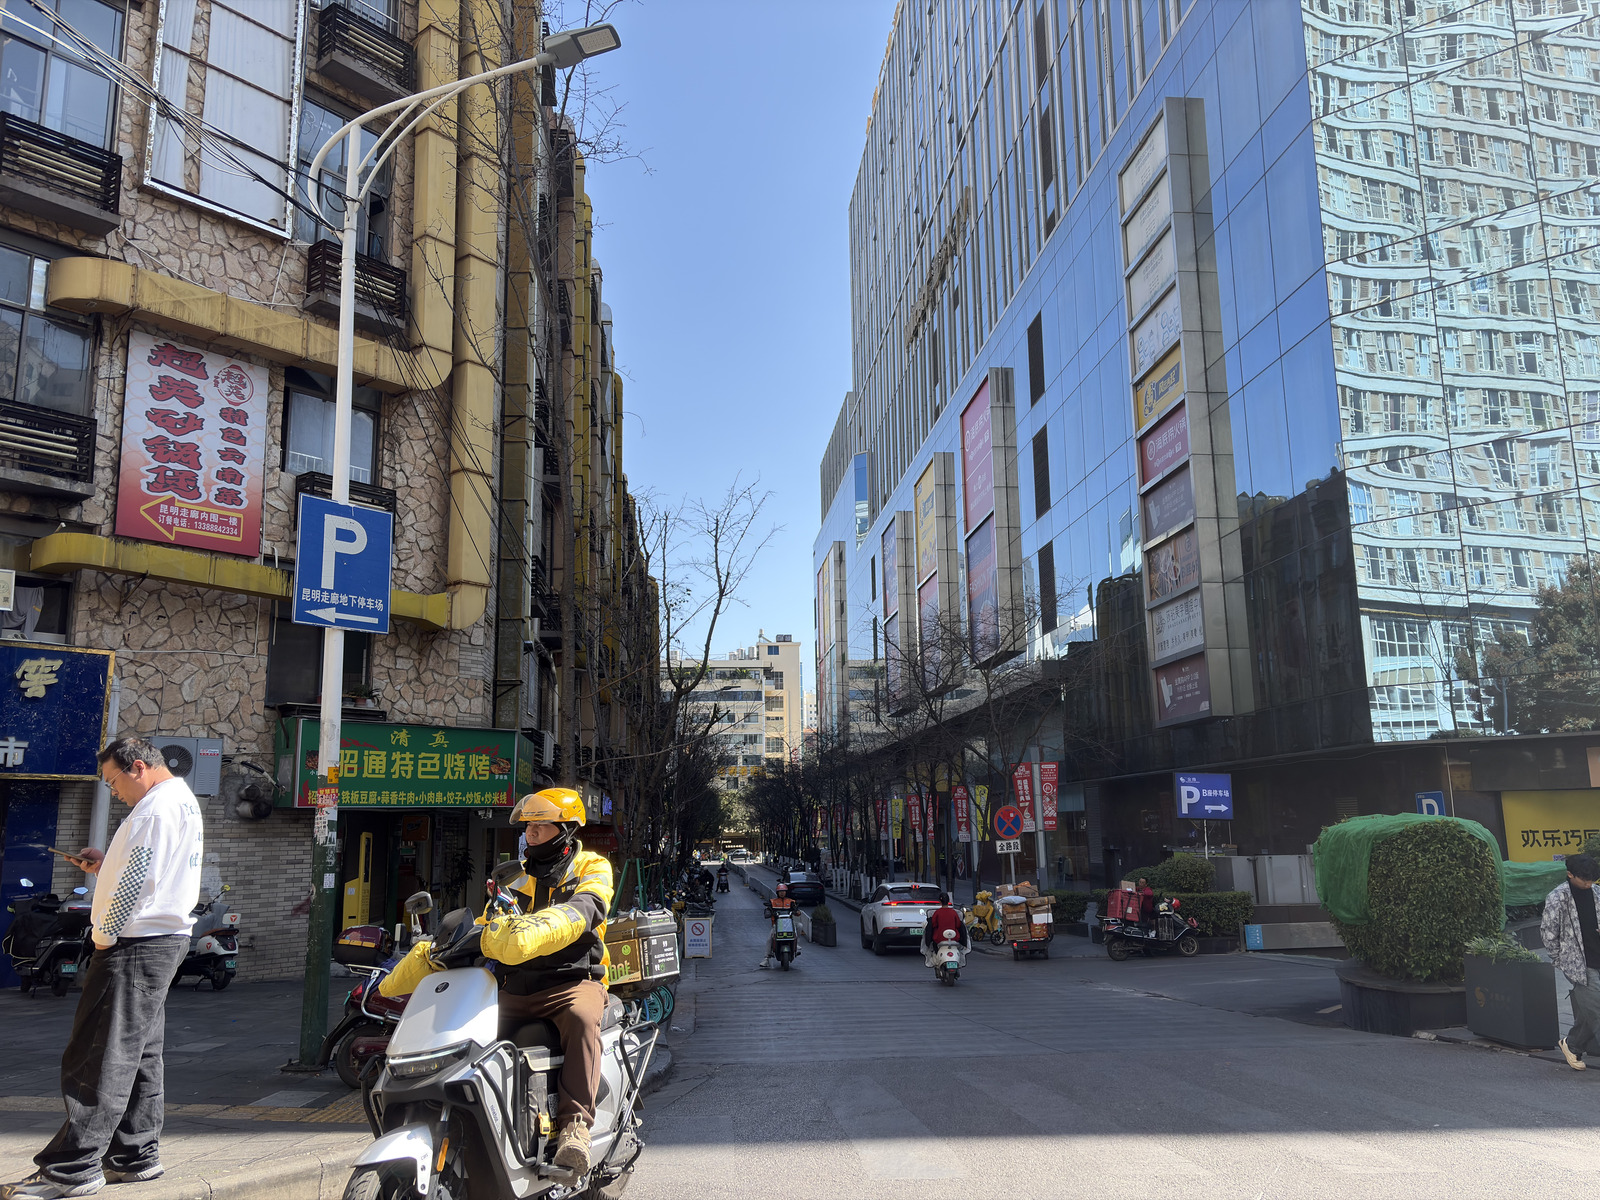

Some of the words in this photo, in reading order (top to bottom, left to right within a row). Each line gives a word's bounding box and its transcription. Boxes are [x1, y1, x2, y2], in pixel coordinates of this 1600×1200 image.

[213, 406, 249, 507] 特色云南菜
[160, 503, 238, 526] 昆明走廊内围一楼
[321, 513, 367, 590] P
[301, 588, 384, 612] 昆明走廊地下停车场
[391, 729, 450, 748] 清真
[1181, 786, 1200, 814] P
[998, 841, 1020, 852] 全路段
